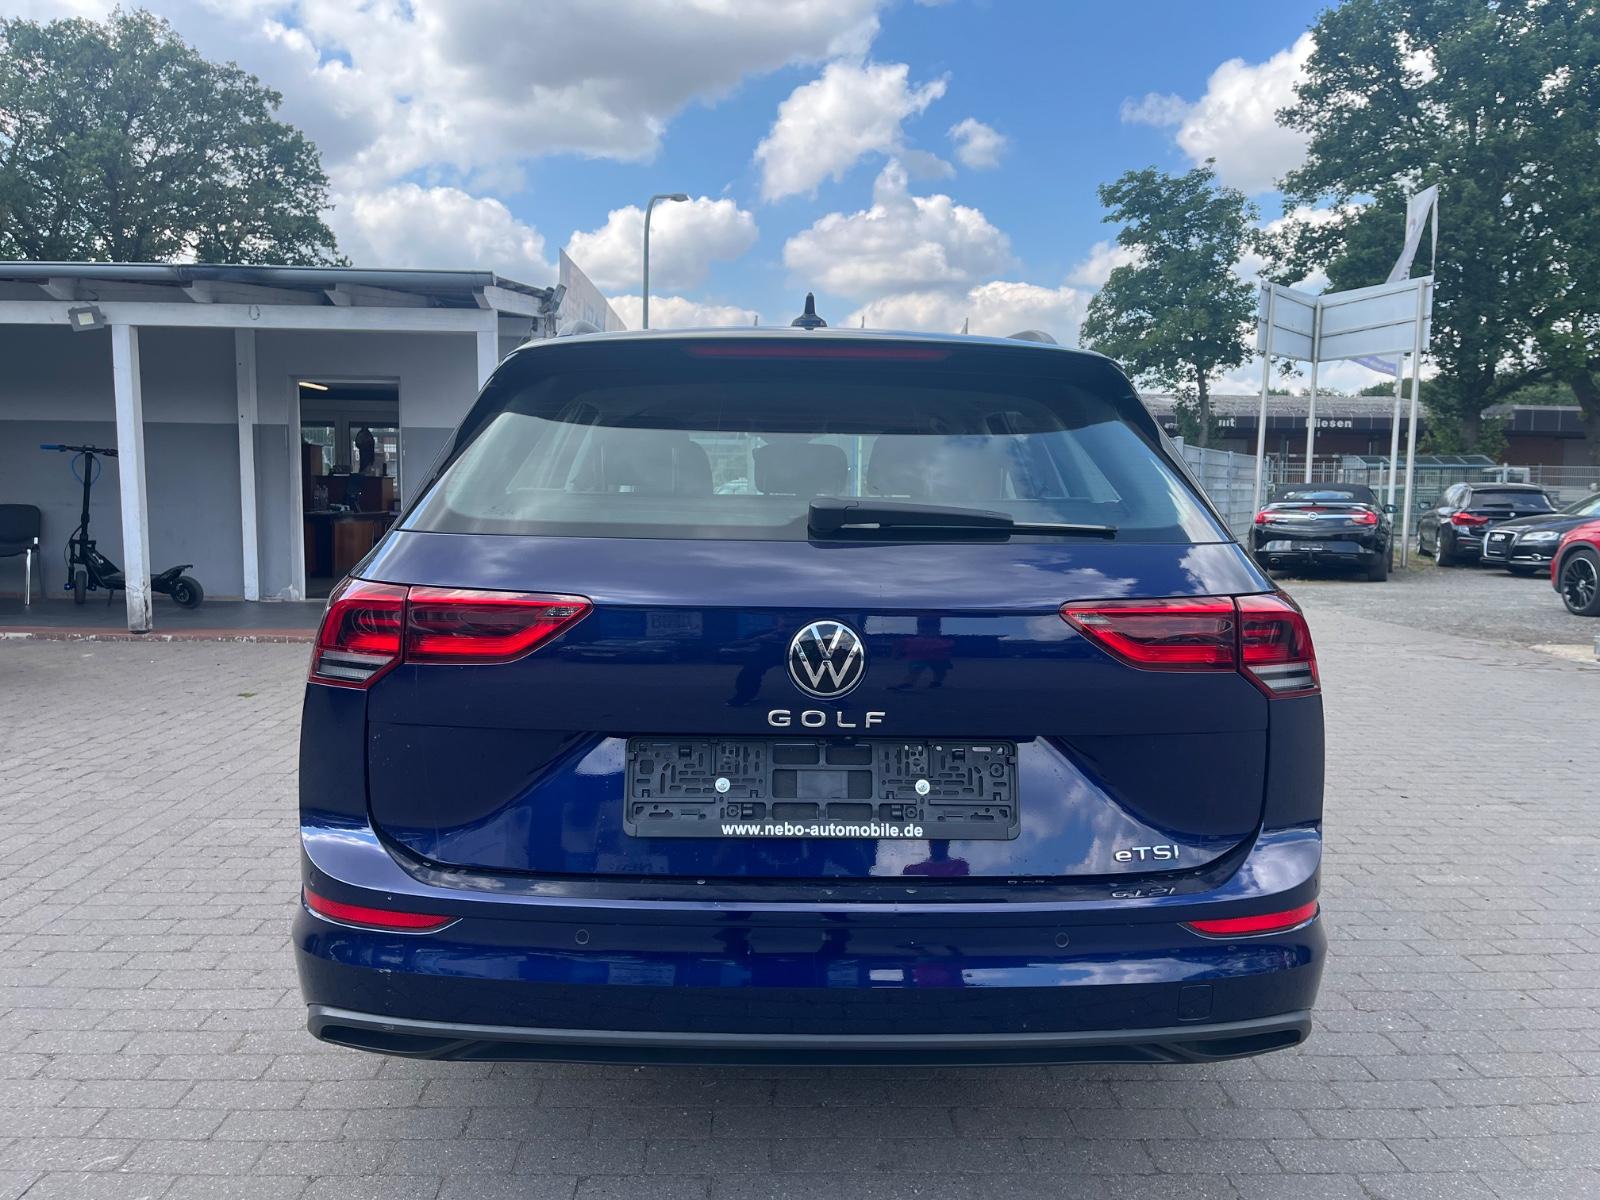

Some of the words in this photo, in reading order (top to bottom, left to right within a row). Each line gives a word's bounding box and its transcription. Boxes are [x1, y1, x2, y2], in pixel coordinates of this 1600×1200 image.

[767, 709, 886, 728] GOLF
[721, 822, 924, 838] www.nebo-automobile.de
[1115, 844, 1180, 862] eTSI
